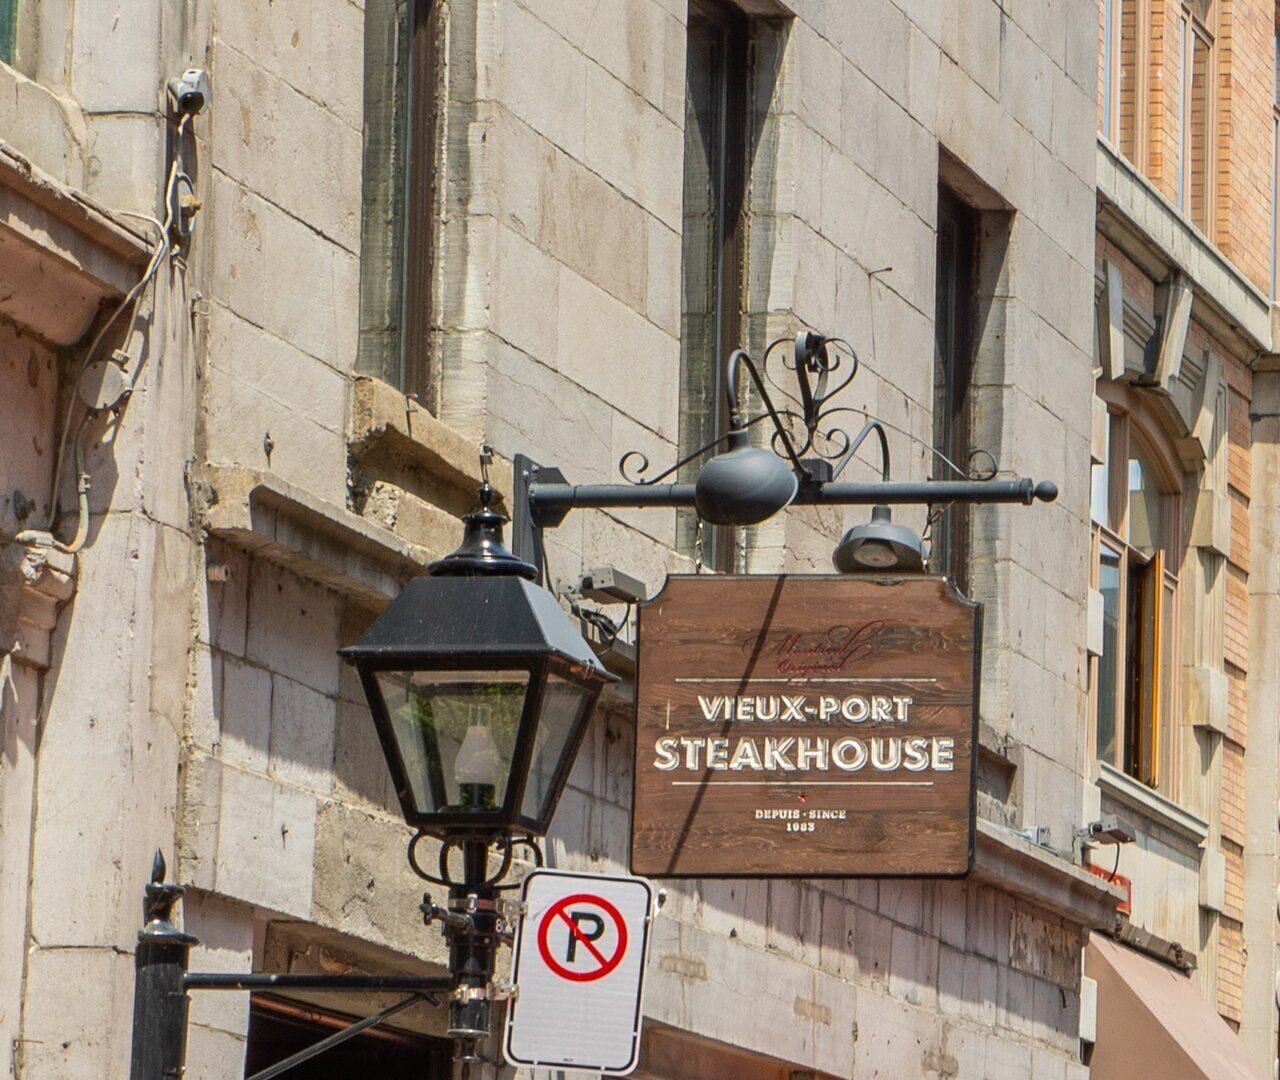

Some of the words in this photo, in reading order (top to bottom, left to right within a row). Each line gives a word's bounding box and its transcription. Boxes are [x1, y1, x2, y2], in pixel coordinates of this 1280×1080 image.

[698, 695, 912, 722] VIEUX-PORT
[653, 736, 955, 772] STEAKHOUSE
[755, 809, 800, 819] DEPUIS
[809, 809, 846, 819] SINCE
